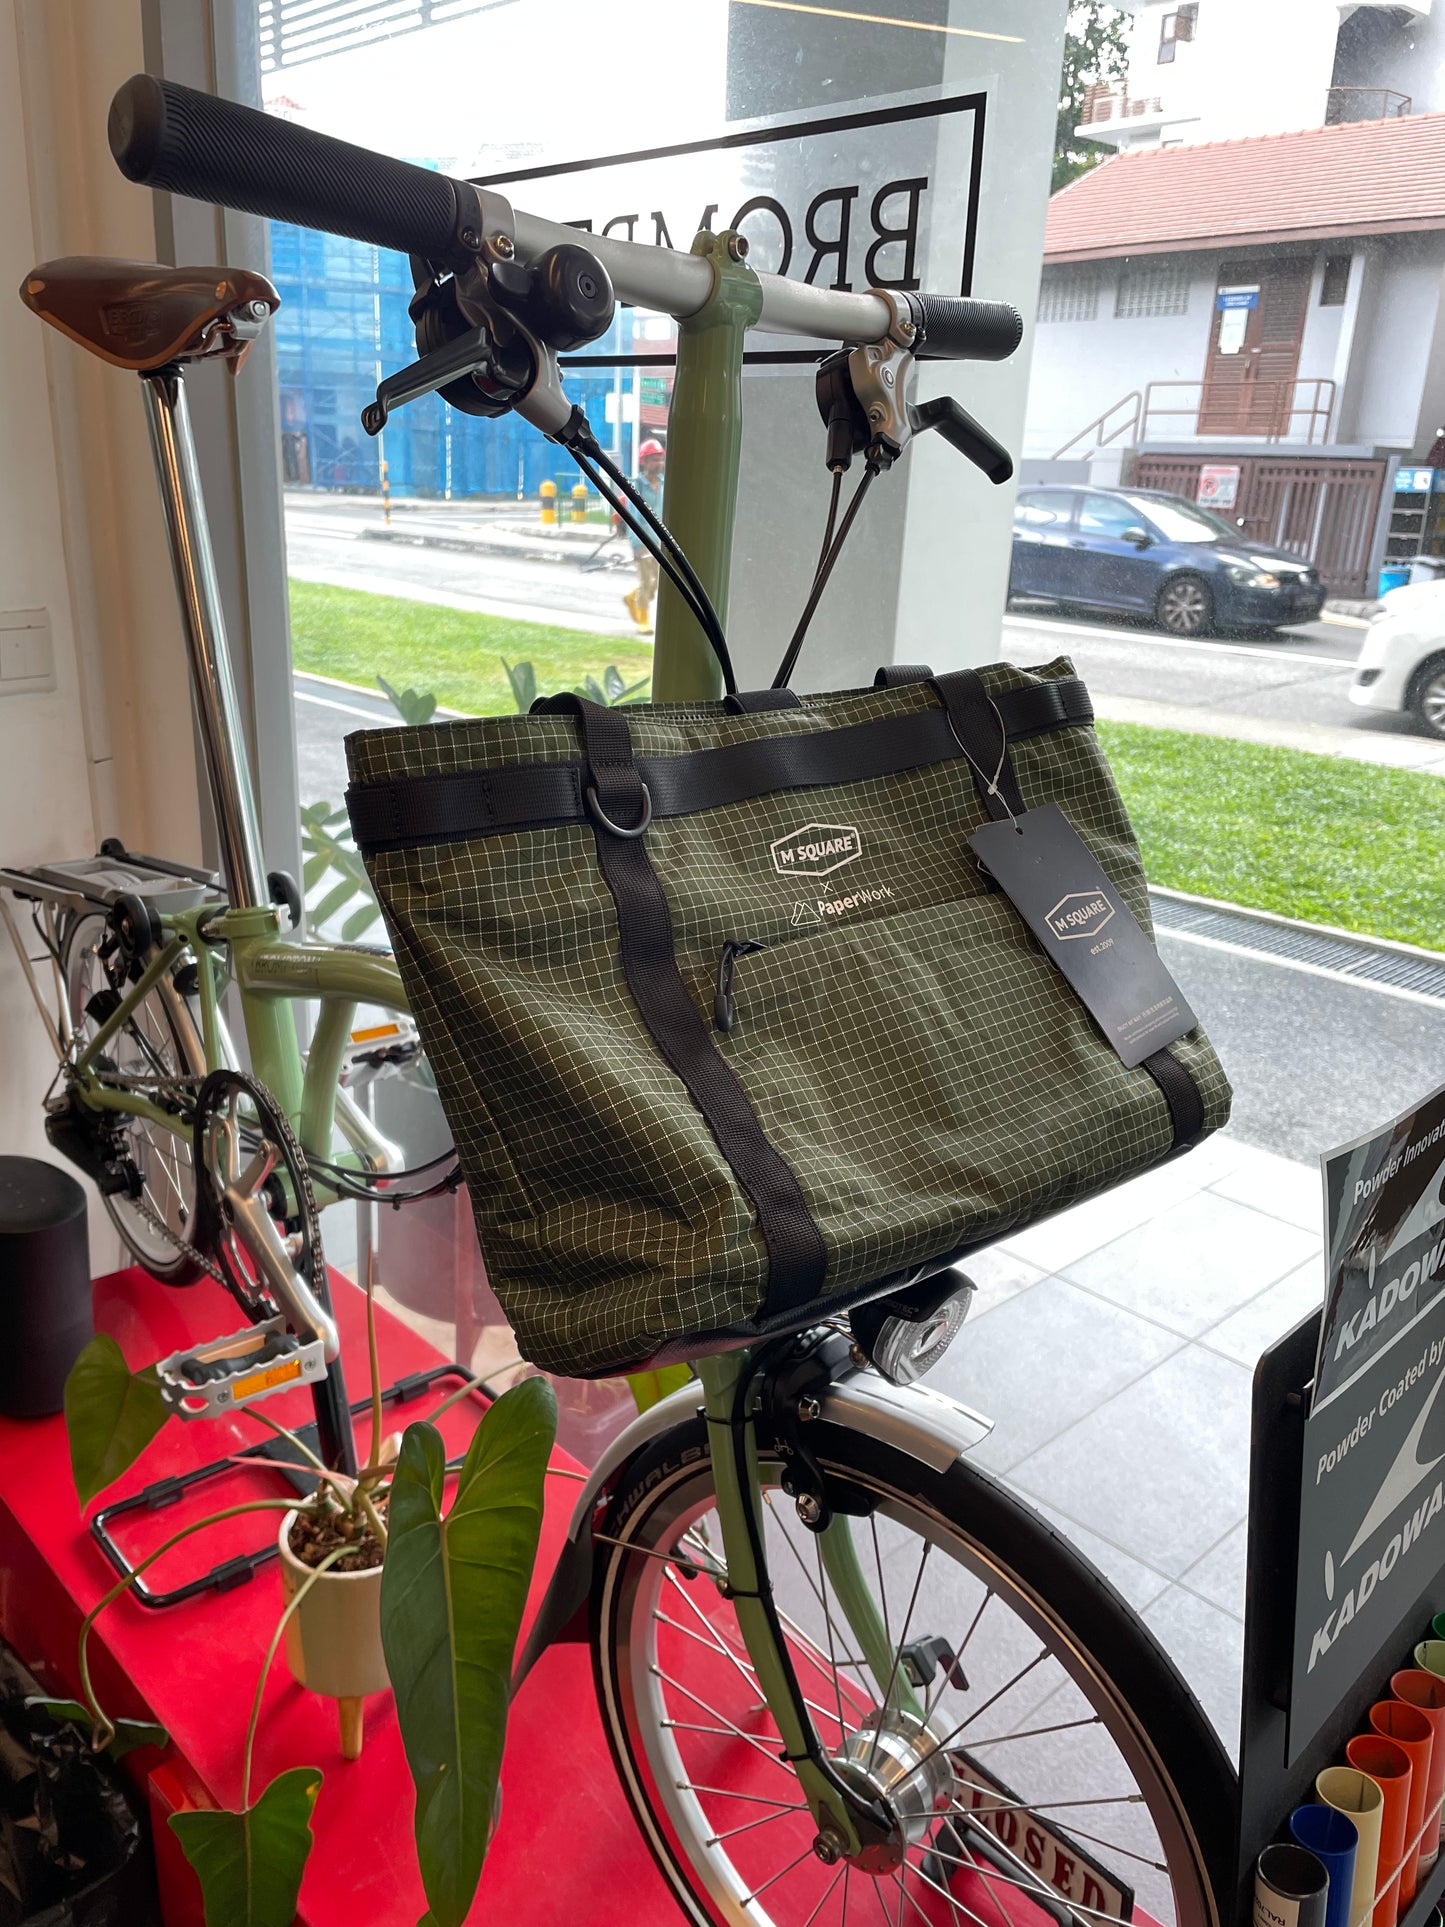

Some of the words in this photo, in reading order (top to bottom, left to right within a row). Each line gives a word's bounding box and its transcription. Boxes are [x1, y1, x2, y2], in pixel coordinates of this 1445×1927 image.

[780, 849, 795, 864] M
[797, 835, 853, 861] SQUARE
[817, 884, 895, 916] PaperWork
[1054, 917, 1069, 932] M
[1066, 899, 1107, 927] SQUARE
[1354, 1152, 1403, 1205] Powder
[1316, 1408, 1376, 1485] Powder
[1378, 1348, 1427, 1417] Coated
[1429, 1336, 1445, 1367] by
[1307, 1481, 1445, 1674] KADOWA
